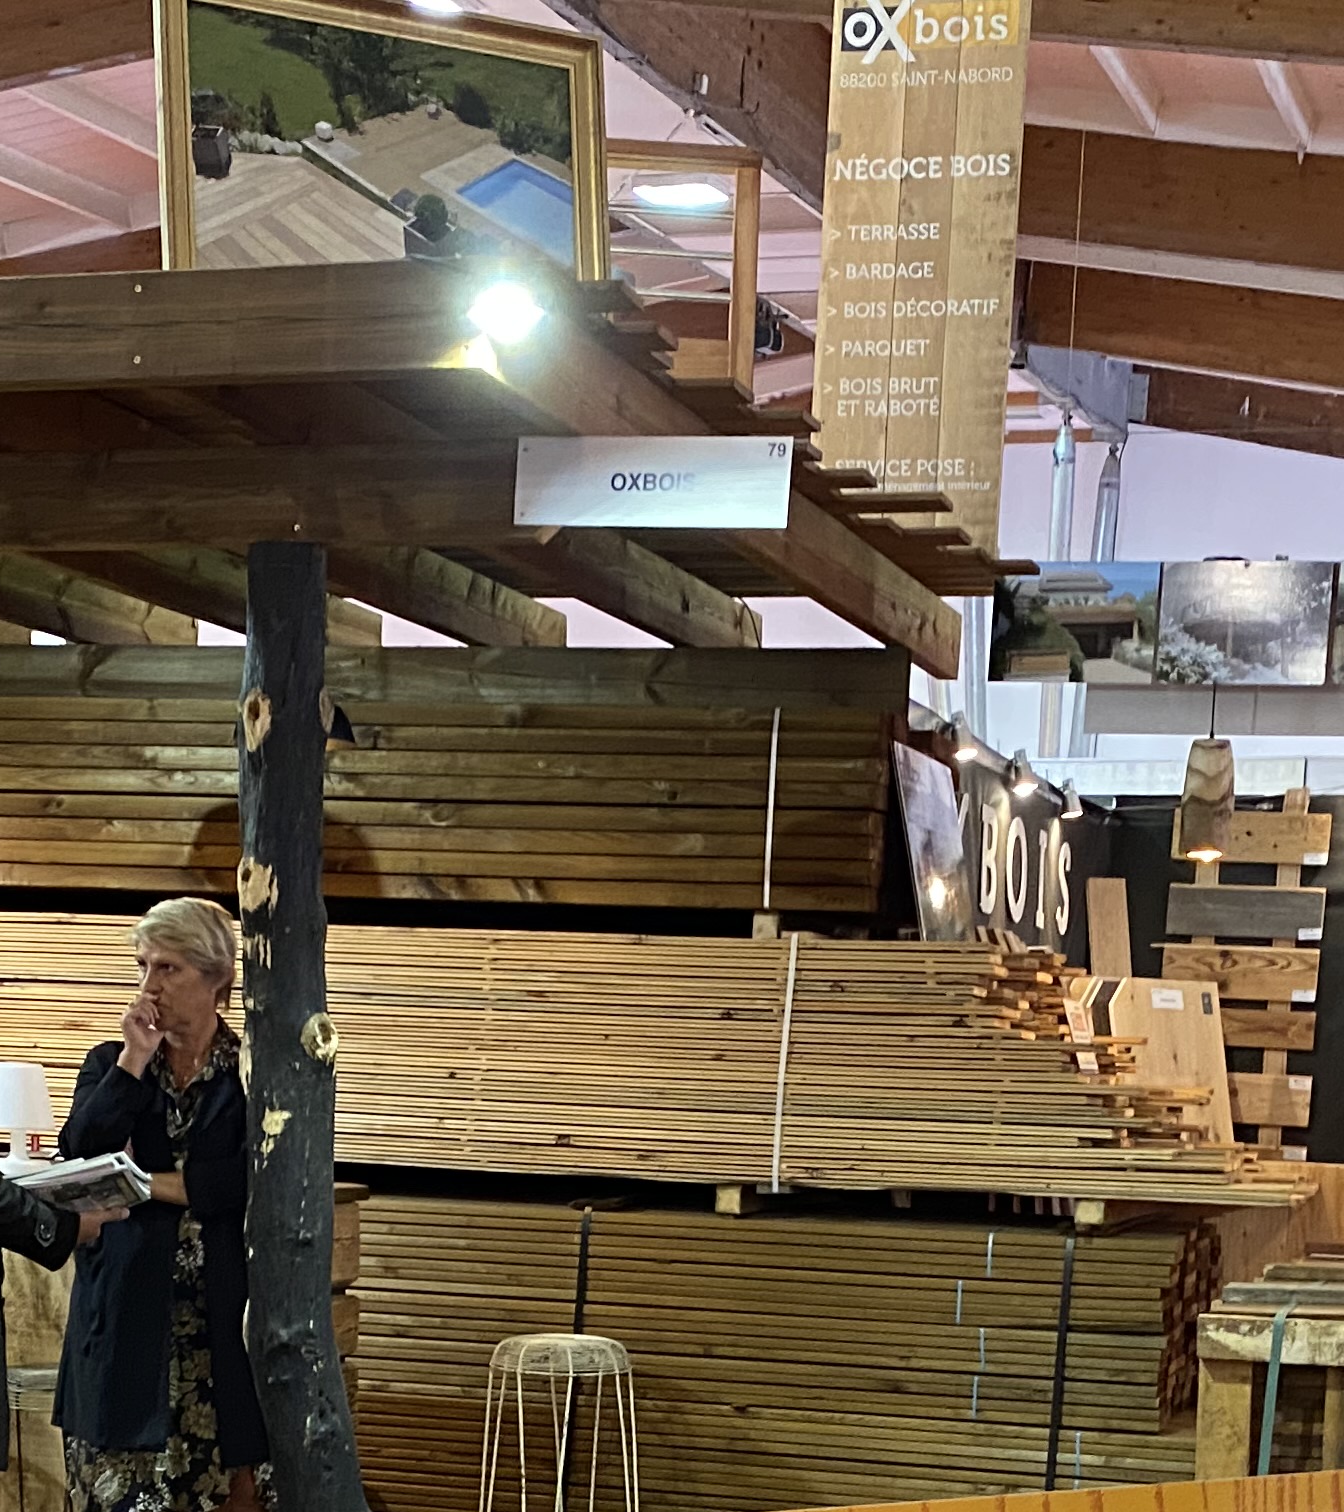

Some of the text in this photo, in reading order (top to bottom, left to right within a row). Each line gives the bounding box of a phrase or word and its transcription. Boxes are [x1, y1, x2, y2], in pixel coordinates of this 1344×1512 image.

[839, 66, 1013, 89] 88200 SAINT-NABORD
[833, 153, 1011, 181] NÉGOCE BOIS
[847, 223, 940, 242] TERRASSE
[845, 261, 935, 281] BARDAGE
[843, 297, 999, 319] BOIS DÉCORATIF
[841, 339, 930, 358] PARQUET
[838, 376, 938, 396] BOIS BRUT
[837, 395, 940, 416] ET RABOTÉ
[767, 442, 787, 458] 79
[610, 473, 696, 491] OXBOIS
[980, 802, 1072, 936] BOIS
